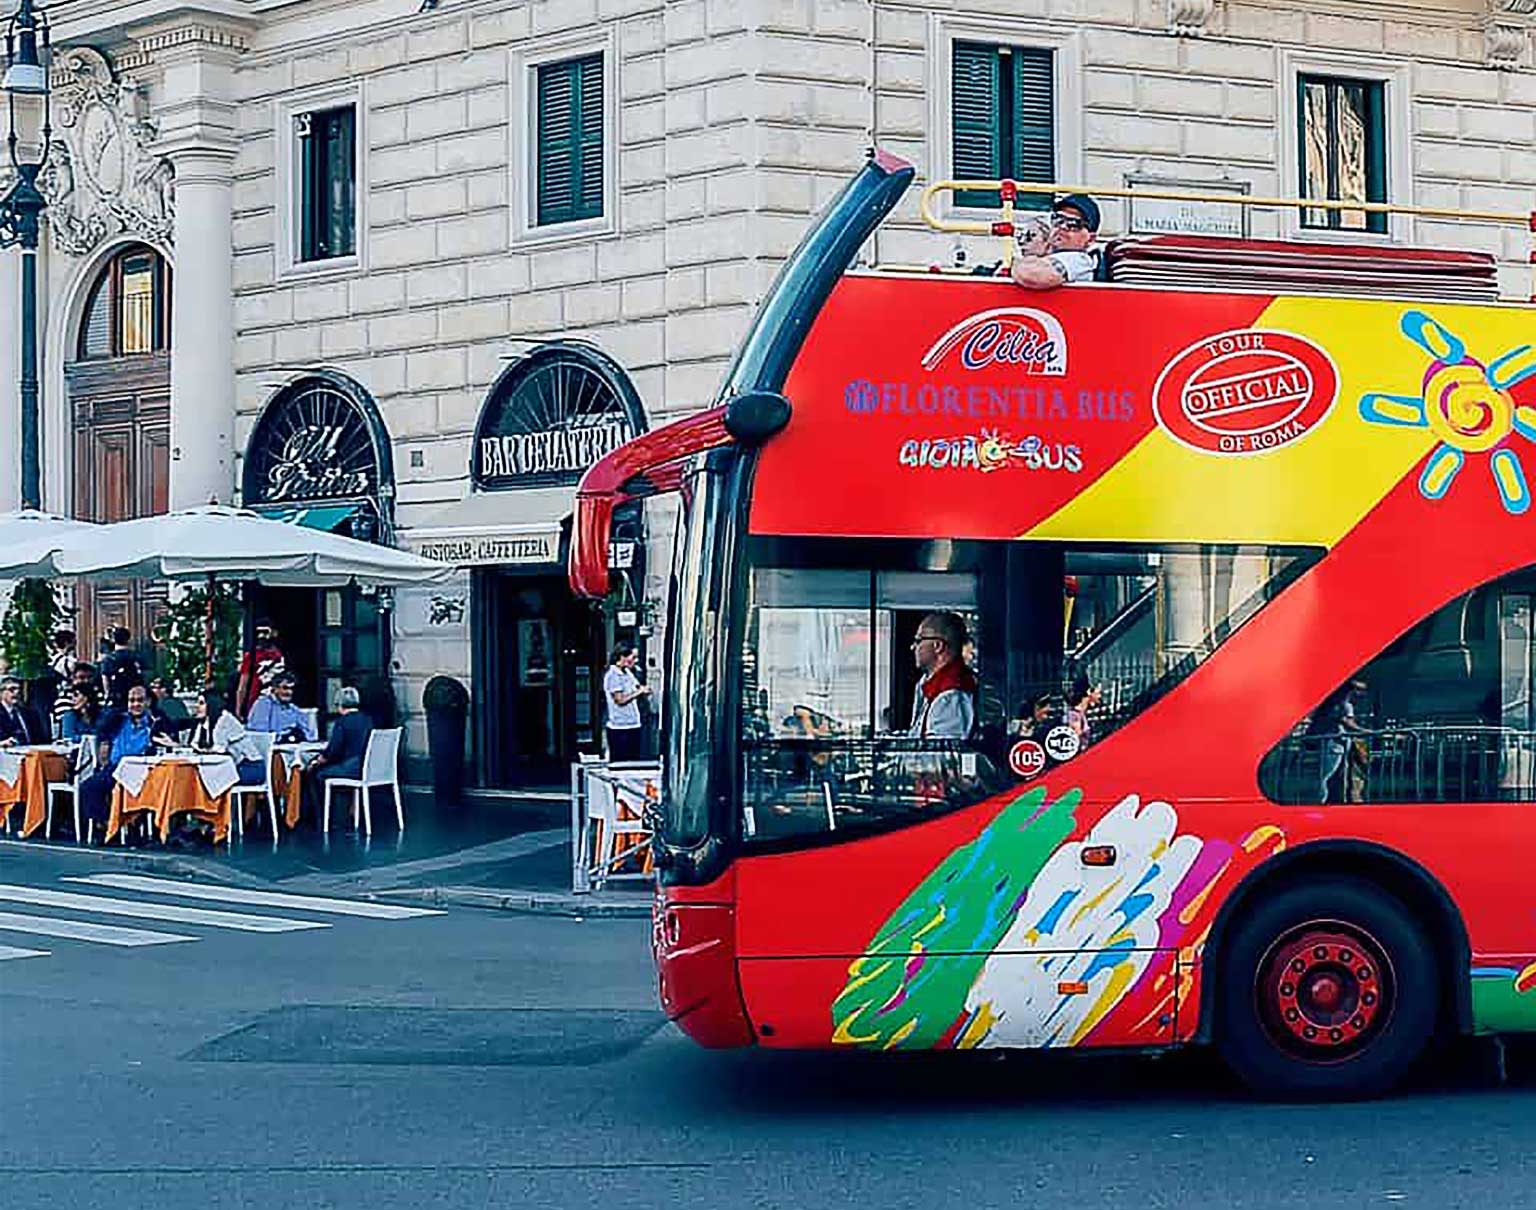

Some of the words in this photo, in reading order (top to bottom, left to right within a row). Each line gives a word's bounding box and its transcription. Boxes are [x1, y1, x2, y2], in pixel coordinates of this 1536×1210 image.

[963, 320, 1059, 371] Cilia
[1206, 335, 1265, 357] TOUR
[882, 382, 1068, 419] FLORENTIA
[1076, 389, 1135, 421] BUS
[1188, 372, 1307, 412] OFFICIAL
[1020, 435, 1084, 472] BUS
[1219, 435, 1245, 451] OF
[1250, 419, 1307, 449] ROMA
[481, 434, 520, 476] BAR
[1014, 751, 1044, 766] 105
